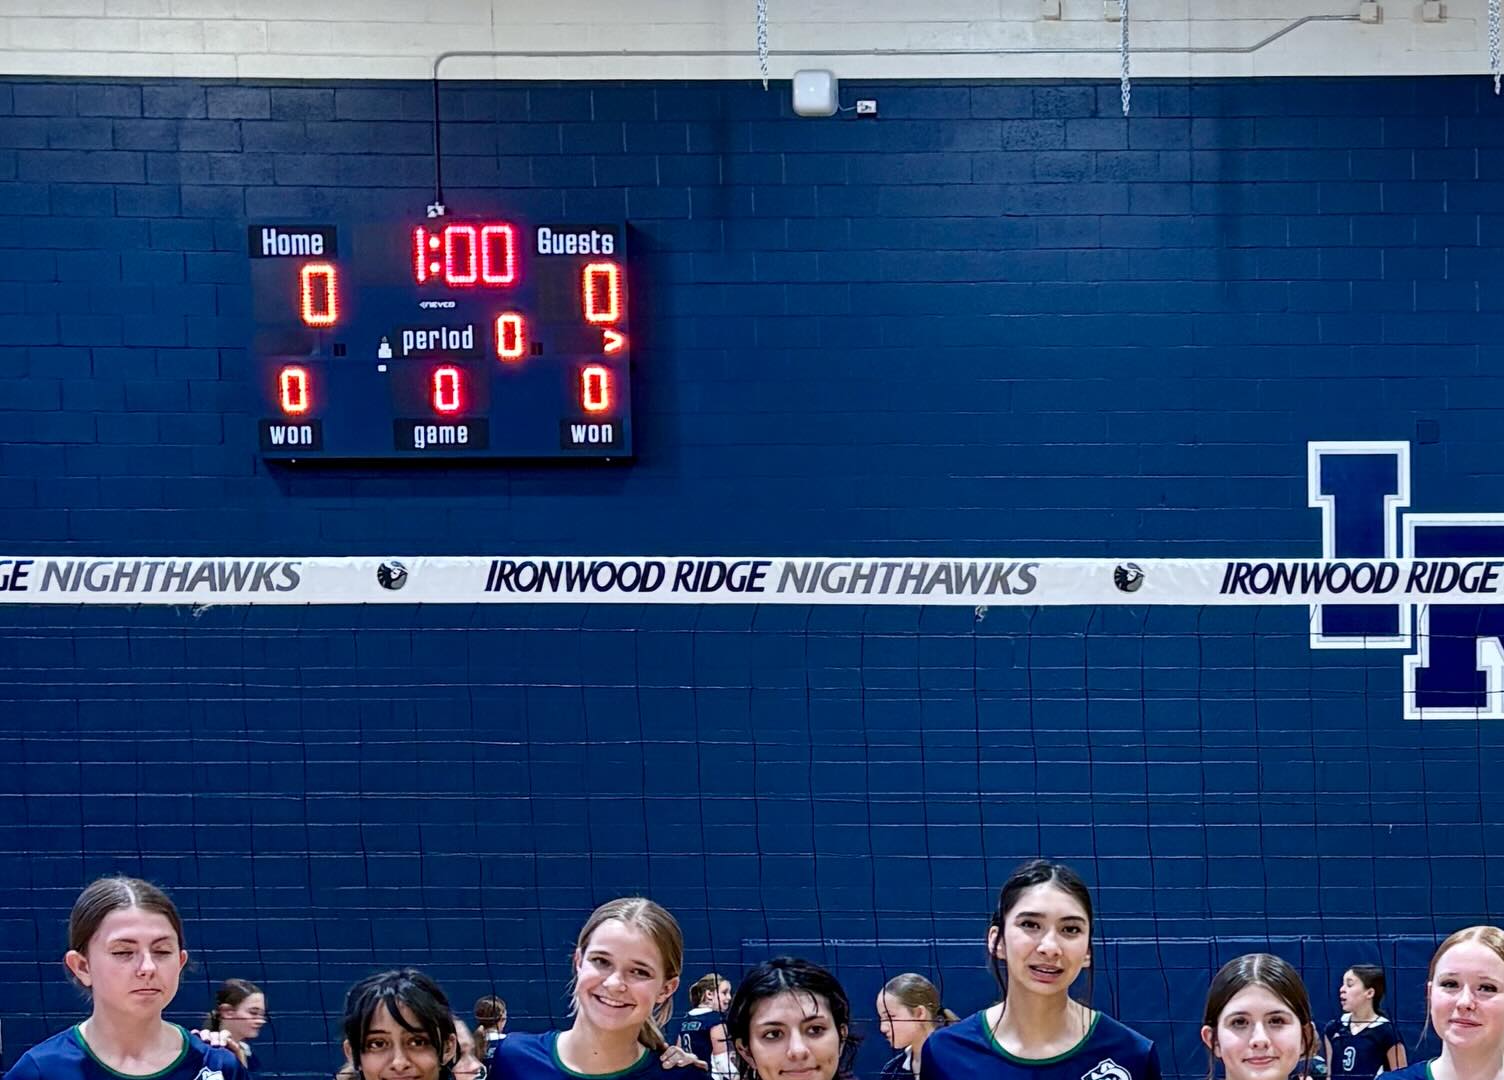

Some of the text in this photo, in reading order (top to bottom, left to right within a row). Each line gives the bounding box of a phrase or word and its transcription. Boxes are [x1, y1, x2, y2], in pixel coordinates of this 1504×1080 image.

[262, 228, 323, 255] Home
[414, 225, 516, 284] 1:00
[537, 227, 614, 255] Guests
[302, 264, 337, 325] 0
[584, 263, 622, 323] 0
[402, 325, 474, 355] period
[497, 313, 524, 358] 0
[281, 366, 307, 412] 0
[434, 366, 460, 412] 0
[583, 365, 609, 412] 0
[270, 425, 312, 445] won
[414, 424, 468, 448] game
[571, 424, 613, 444] won
[40, 561, 301, 592] NIGHTHAWKS
[484, 560, 1040, 594] IRONWOOD RIDGE NIGHTHAWKS
[1220, 562, 1399, 594] IRONWOOD
[1404, 561, 1504, 594] RIDGE
[1343, 1046, 1357, 1071] 3
